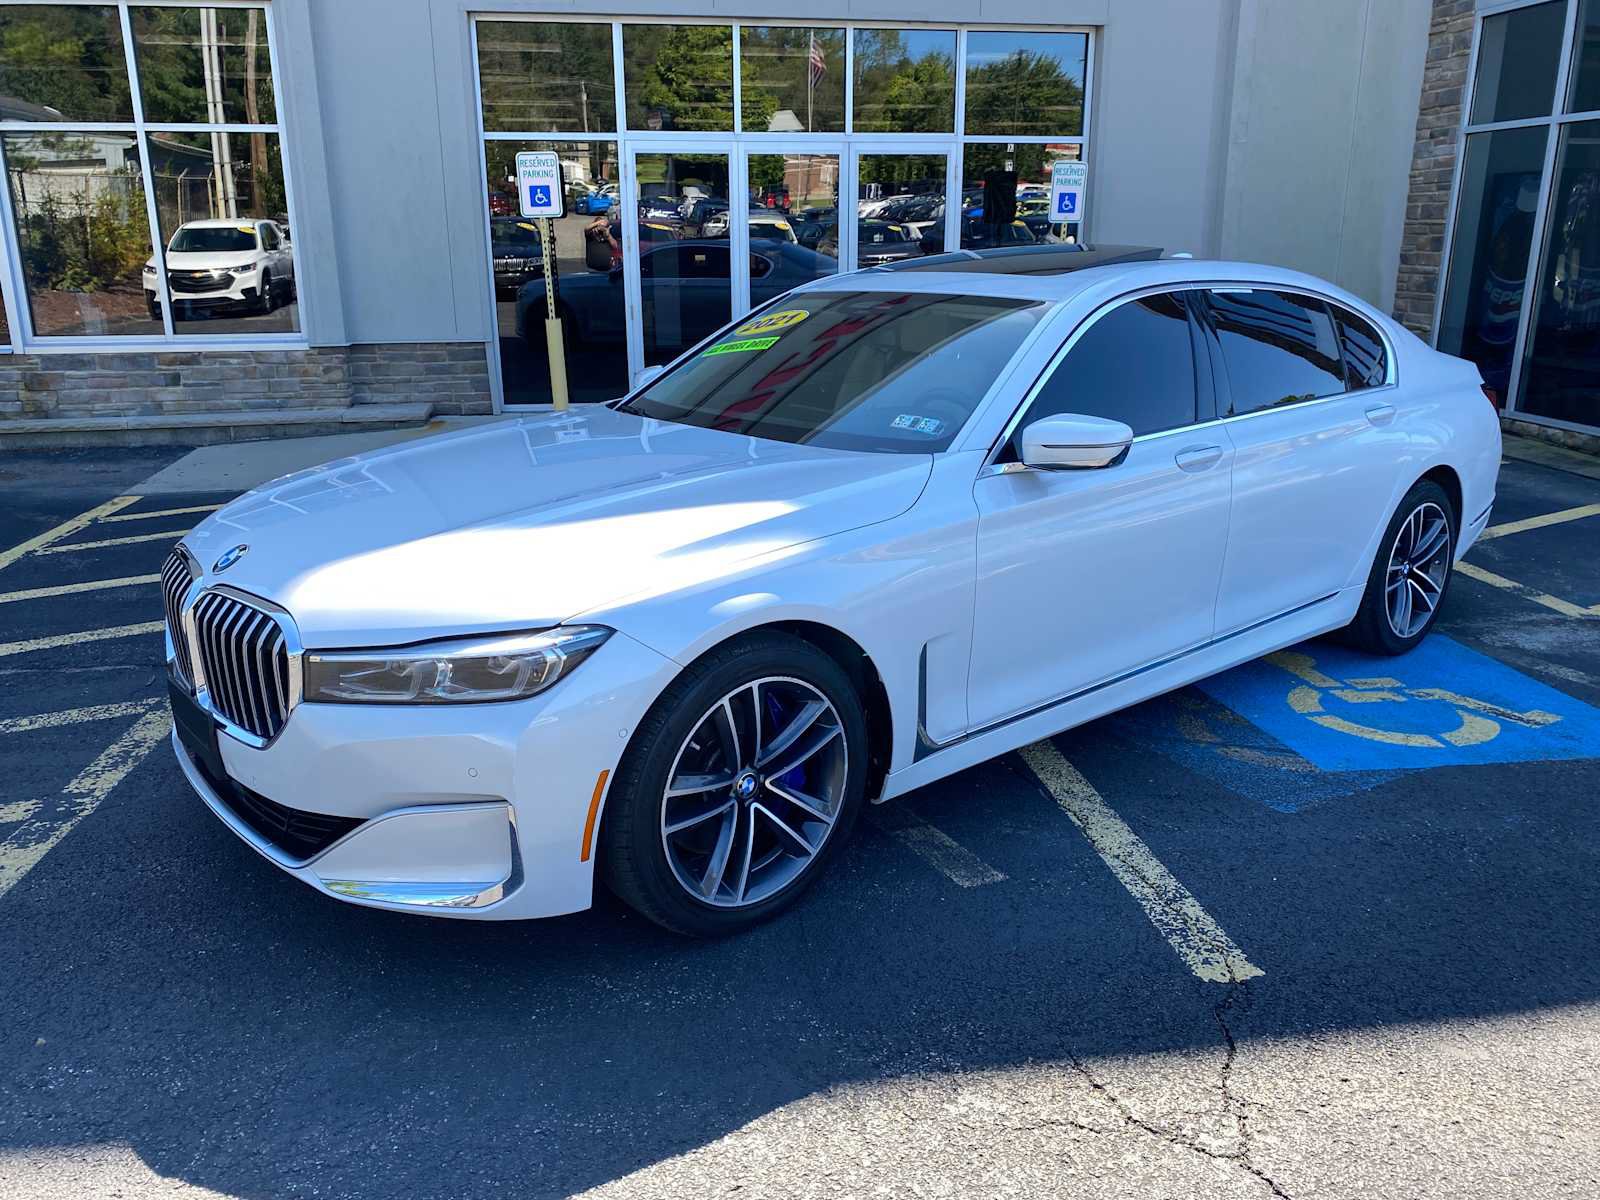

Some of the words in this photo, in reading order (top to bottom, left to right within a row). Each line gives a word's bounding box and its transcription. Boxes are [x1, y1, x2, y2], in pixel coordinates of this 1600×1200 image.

[520, 159, 555, 168] RESERVED
[523, 169, 554, 178] PARKING
[1056, 167, 1085, 176] RESERVED
[1056, 177, 1082, 185] PARKING
[1484, 280, 1524, 304] PEPS
[740, 311, 803, 333] 2021
